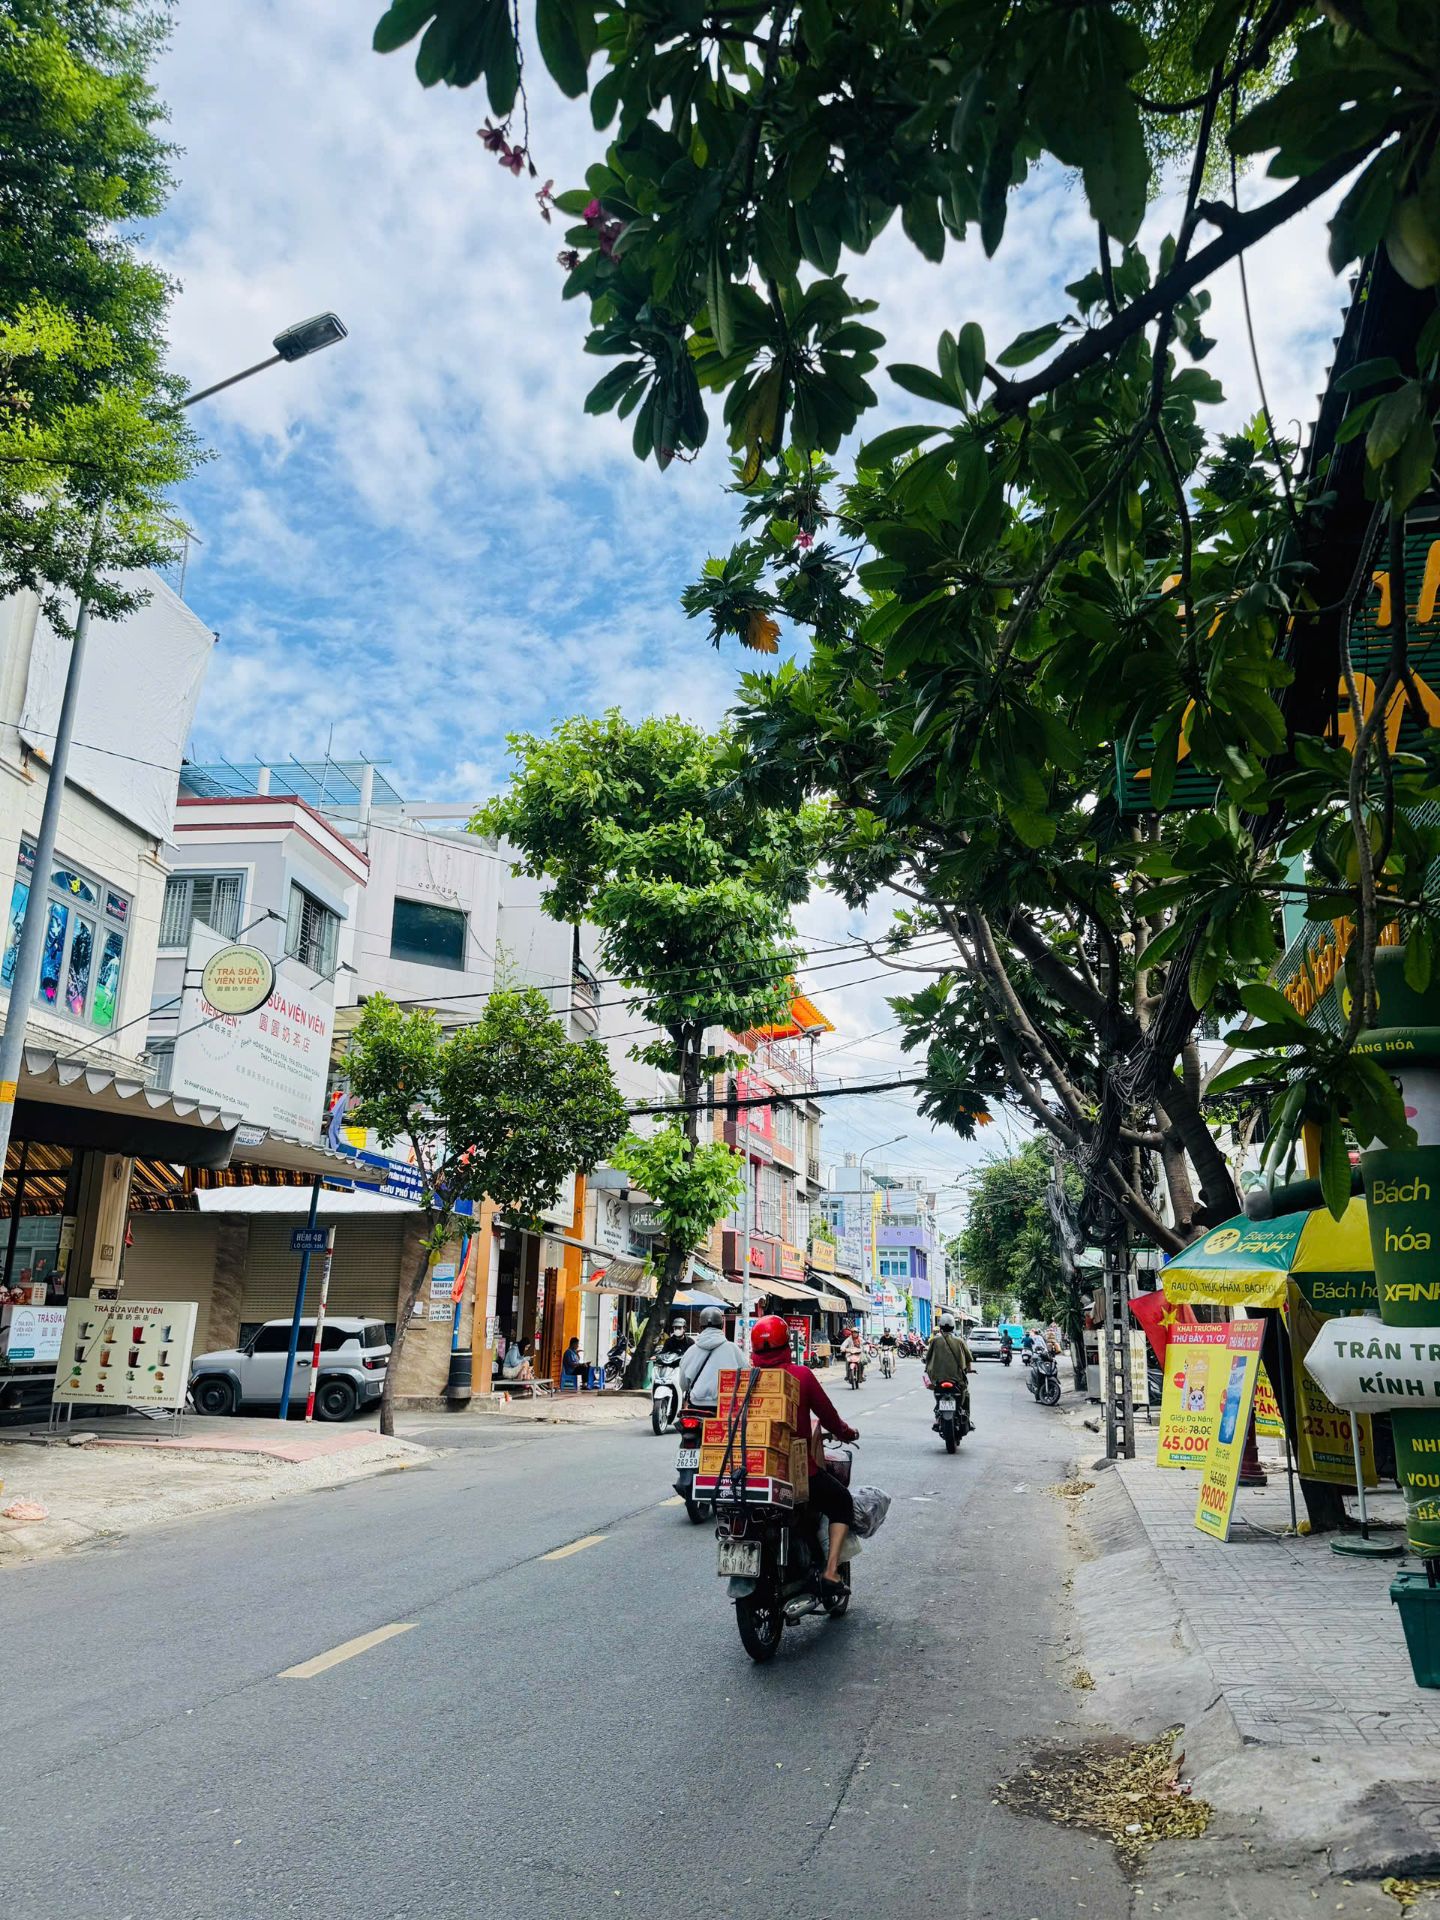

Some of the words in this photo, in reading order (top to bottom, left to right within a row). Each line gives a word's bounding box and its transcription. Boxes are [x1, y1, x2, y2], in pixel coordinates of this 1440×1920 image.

[217, 967, 235, 976] TRÀ
[238, 966, 259, 976] SỮA
[288, 1003, 306, 1026] VIÊN
[308, 1014, 326, 1037] VIÊN
[1386, 1038, 1415, 1051] HÓA
[380, 1184, 394, 1194] KHU
[395, 1186, 410, 1198] PHỐ
[1373, 1176, 1430, 1204] Bách
[296, 1230, 312, 1242] HẺM
[313, 1233, 322, 1242] 48
[1244, 1231, 1274, 1240] Bách
[1385, 1226, 1431, 1252] hóa
[1231, 1240, 1288, 1253] XANH
[1171, 1282, 1188, 1291] RAU
[1313, 1281, 1356, 1299] Bách
[94, 1304, 110, 1312] TRÀ
[110, 1304, 126, 1313] SỮA
[127, 1304, 145, 1314] VIÊN
[146, 1306, 164, 1315] VIÊN
[38, 1312, 49, 1322] TRÀ
[1194, 1324, 1222, 1332] TRƯƠNG
[1172, 1332, 1188, 1342] THỨ
[1189, 1332, 1205, 1344] BẢY,
[1334, 1337, 1401, 1360] TRÂN
[1410, 1344, 1440, 1362] TR
[1358, 1371, 1424, 1397] KÍNH
[1172, 1425, 1188, 1433] Gói:
[676, 1458, 698, 1466] 26259
[1407, 1472, 1440, 1488] VOU
